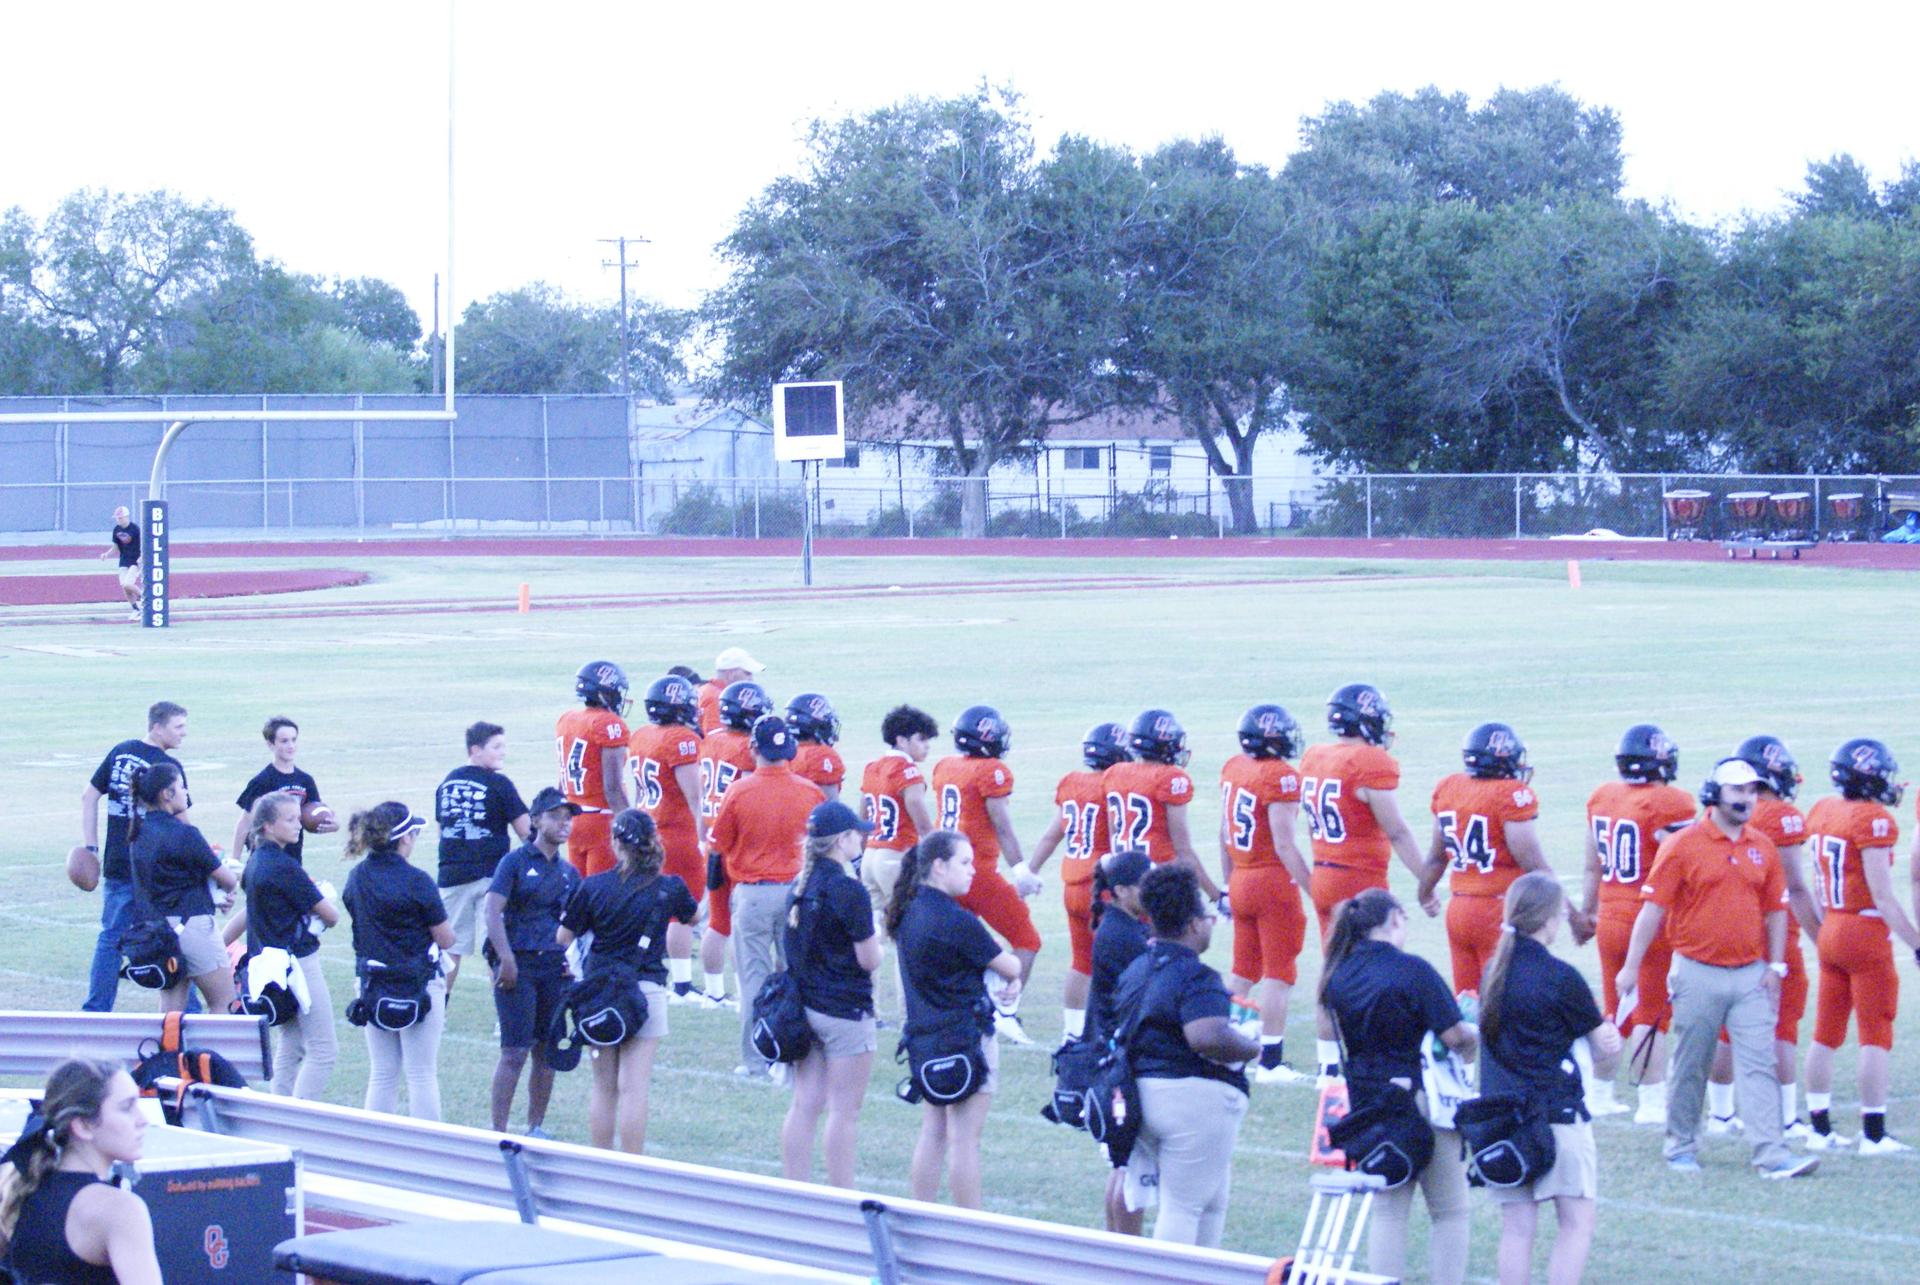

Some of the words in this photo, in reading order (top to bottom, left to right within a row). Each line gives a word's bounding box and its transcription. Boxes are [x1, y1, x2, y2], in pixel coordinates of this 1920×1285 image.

[152, 507, 163, 626] BULLDOGS
[941, 784, 961, 832] 8
[1062, 800, 1099, 859] 21
[1106, 792, 1152, 855] 22
[1437, 810, 1496, 874] 54
[1591, 815, 1640, 884] 50
